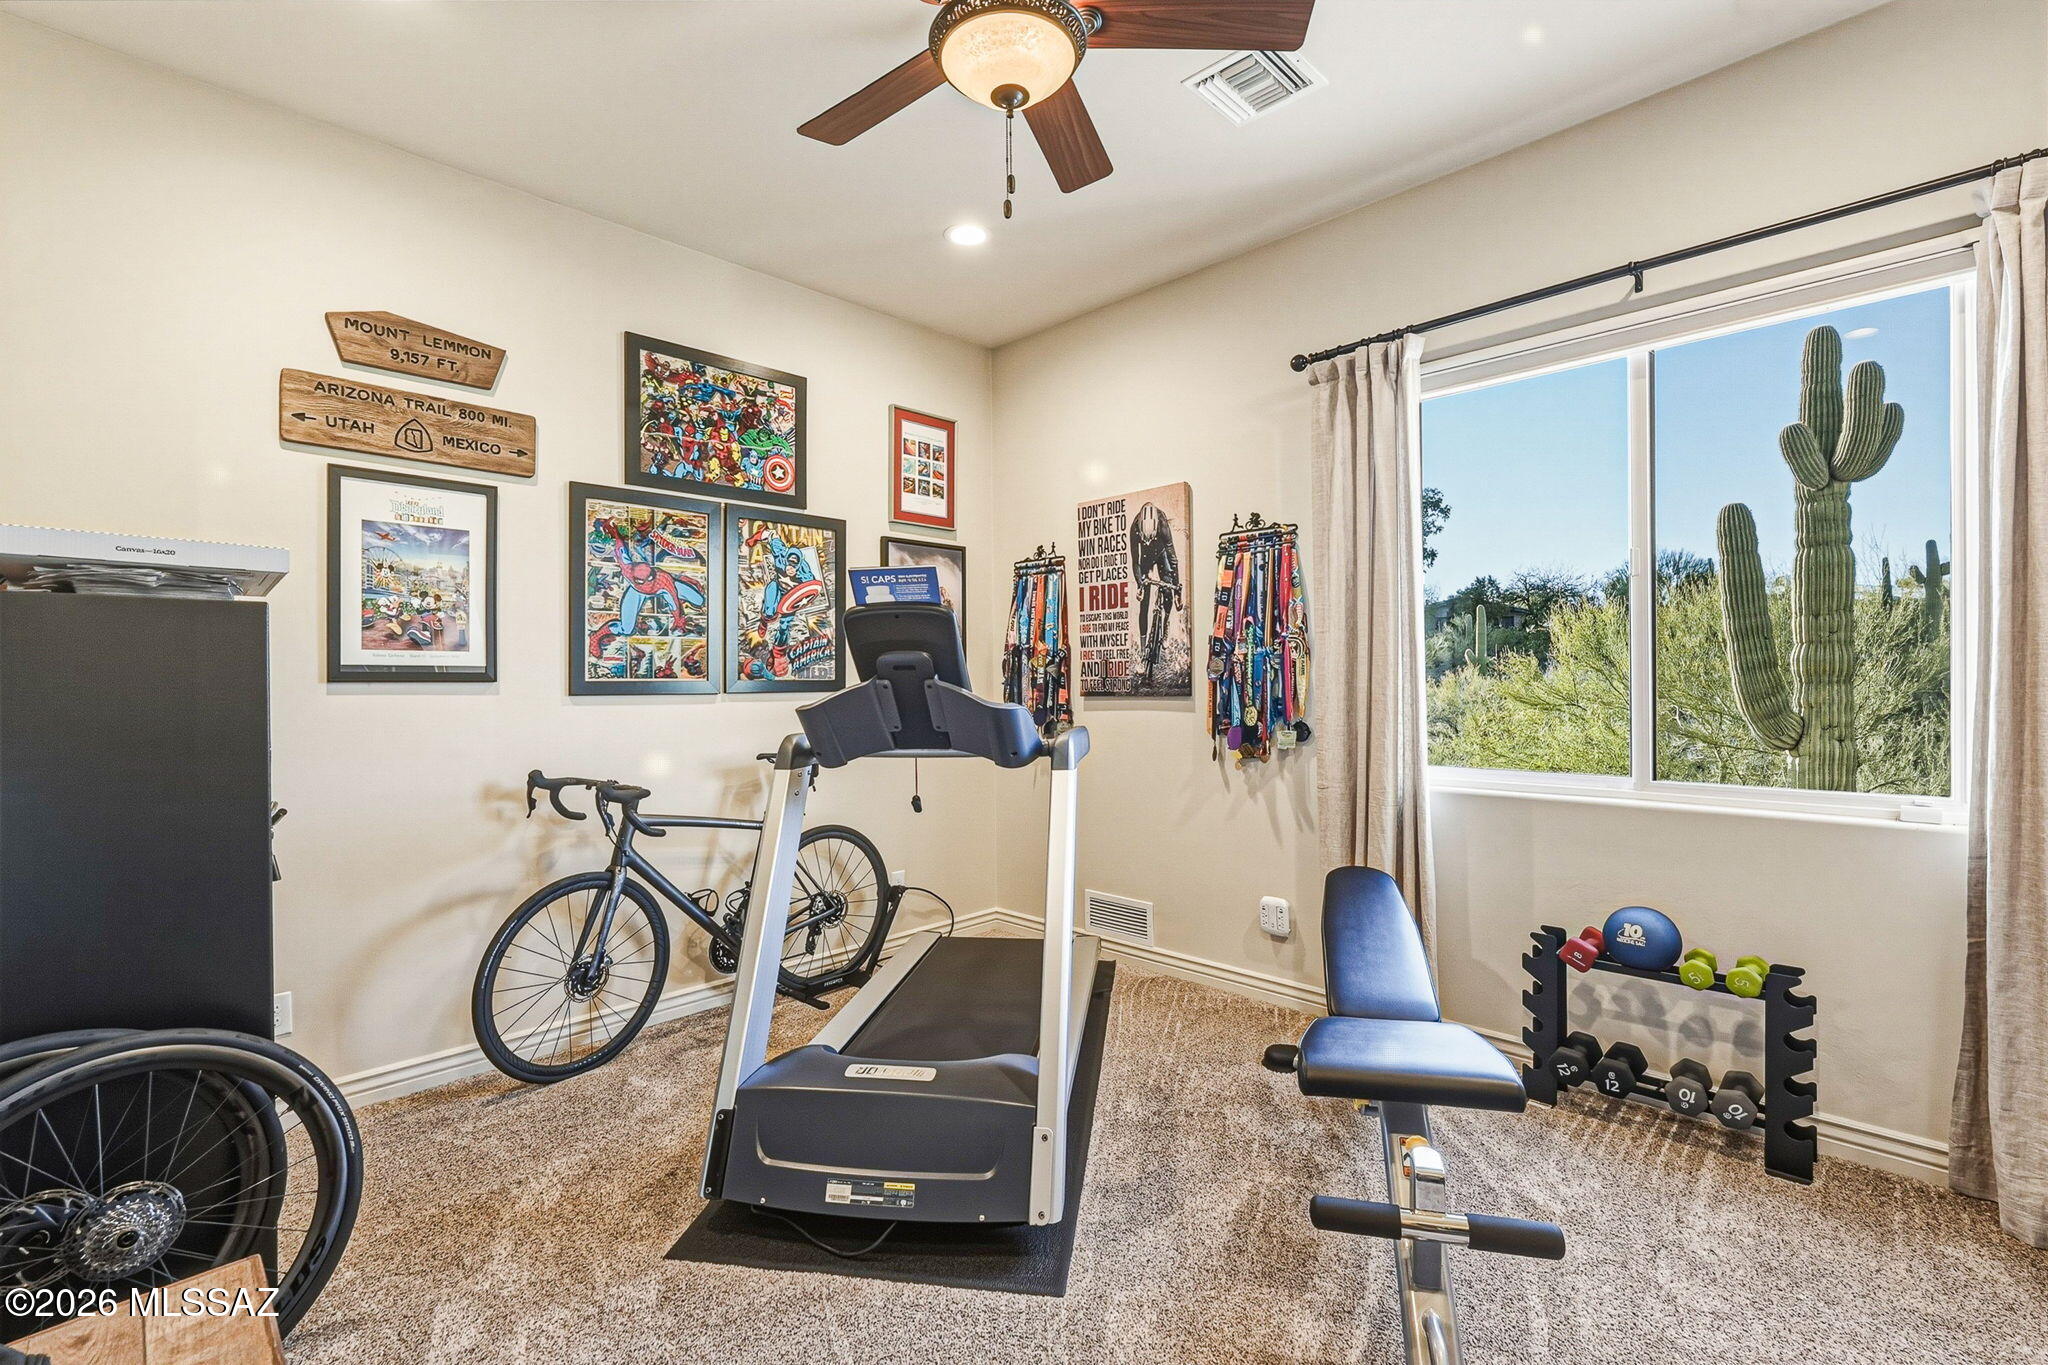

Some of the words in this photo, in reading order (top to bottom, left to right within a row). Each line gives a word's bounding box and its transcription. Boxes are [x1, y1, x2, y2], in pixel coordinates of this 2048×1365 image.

[344, 317, 409, 341] MOUNT
[423, 335, 491, 359] LEMMON
[390, 349, 429, 367] 9,157
[437, 358, 460, 373] FT.
[314, 381, 395, 406] ARIZONA
[404, 397, 452, 418] TRAIL
[458, 408, 485, 422] 800
[492, 414, 512, 428] MI.
[325, 415, 375, 434] UTAH
[442, 436, 501, 455] MEXICO
[1082, 503, 1105, 520] DON'T
[1107, 499, 1126, 515] RIDE
[1078, 520, 1091, 538] MY
[1094, 517, 1113, 536] BIKE
[1115, 514, 1126, 532] TO
[1078, 538, 1095, 557] WIN
[1098, 533, 1127, 554] RACES
[1078, 557, 1090, 570] NOR
[1091, 556, 1099, 569] DO
[1104, 554, 1118, 567] RIDE
[1120, 553, 1127, 565] TO
[871, 575, 896, 584] CAPS
[1078, 571, 1094, 584] GET
[1096, 566, 1128, 582] PLACES
[1079, 587, 1084, 612] I
[1089, 582, 1129, 611] RIDE
[1080, 614, 1085, 622] TO
[1086, 613, 1101, 621] ESCAPE
[1102, 612, 1112, 620] THIS
[1113, 611, 1128, 620] WORLD
[1092, 623, 1097, 632] TO
[1098, 623, 1108, 632] FIND
[1115, 621, 1129, 631] PEACE
[1080, 634, 1098, 648] WITH
[1100, 633, 1128, 647] MYSELF
[1095, 650, 1102, 659] TO
[1102, 649, 1115, 660] FEEL
[1116, 649, 1130, 659] FREE
[1081, 661, 1099, 677] AND
[1108, 661, 1129, 677] RIDE
[1081, 680, 1088, 691] TO
[1089, 679, 1104, 692] FEEL
[1104, 679, 1131, 692] STRONG
[1623, 923, 1643, 938] 10
[1556, 1063, 1571, 1076] 12
[1605, 1079, 1620, 1092] 12
[1679, 1088, 1696, 1104] 10
[1728, 1104, 1748, 1120] 10
